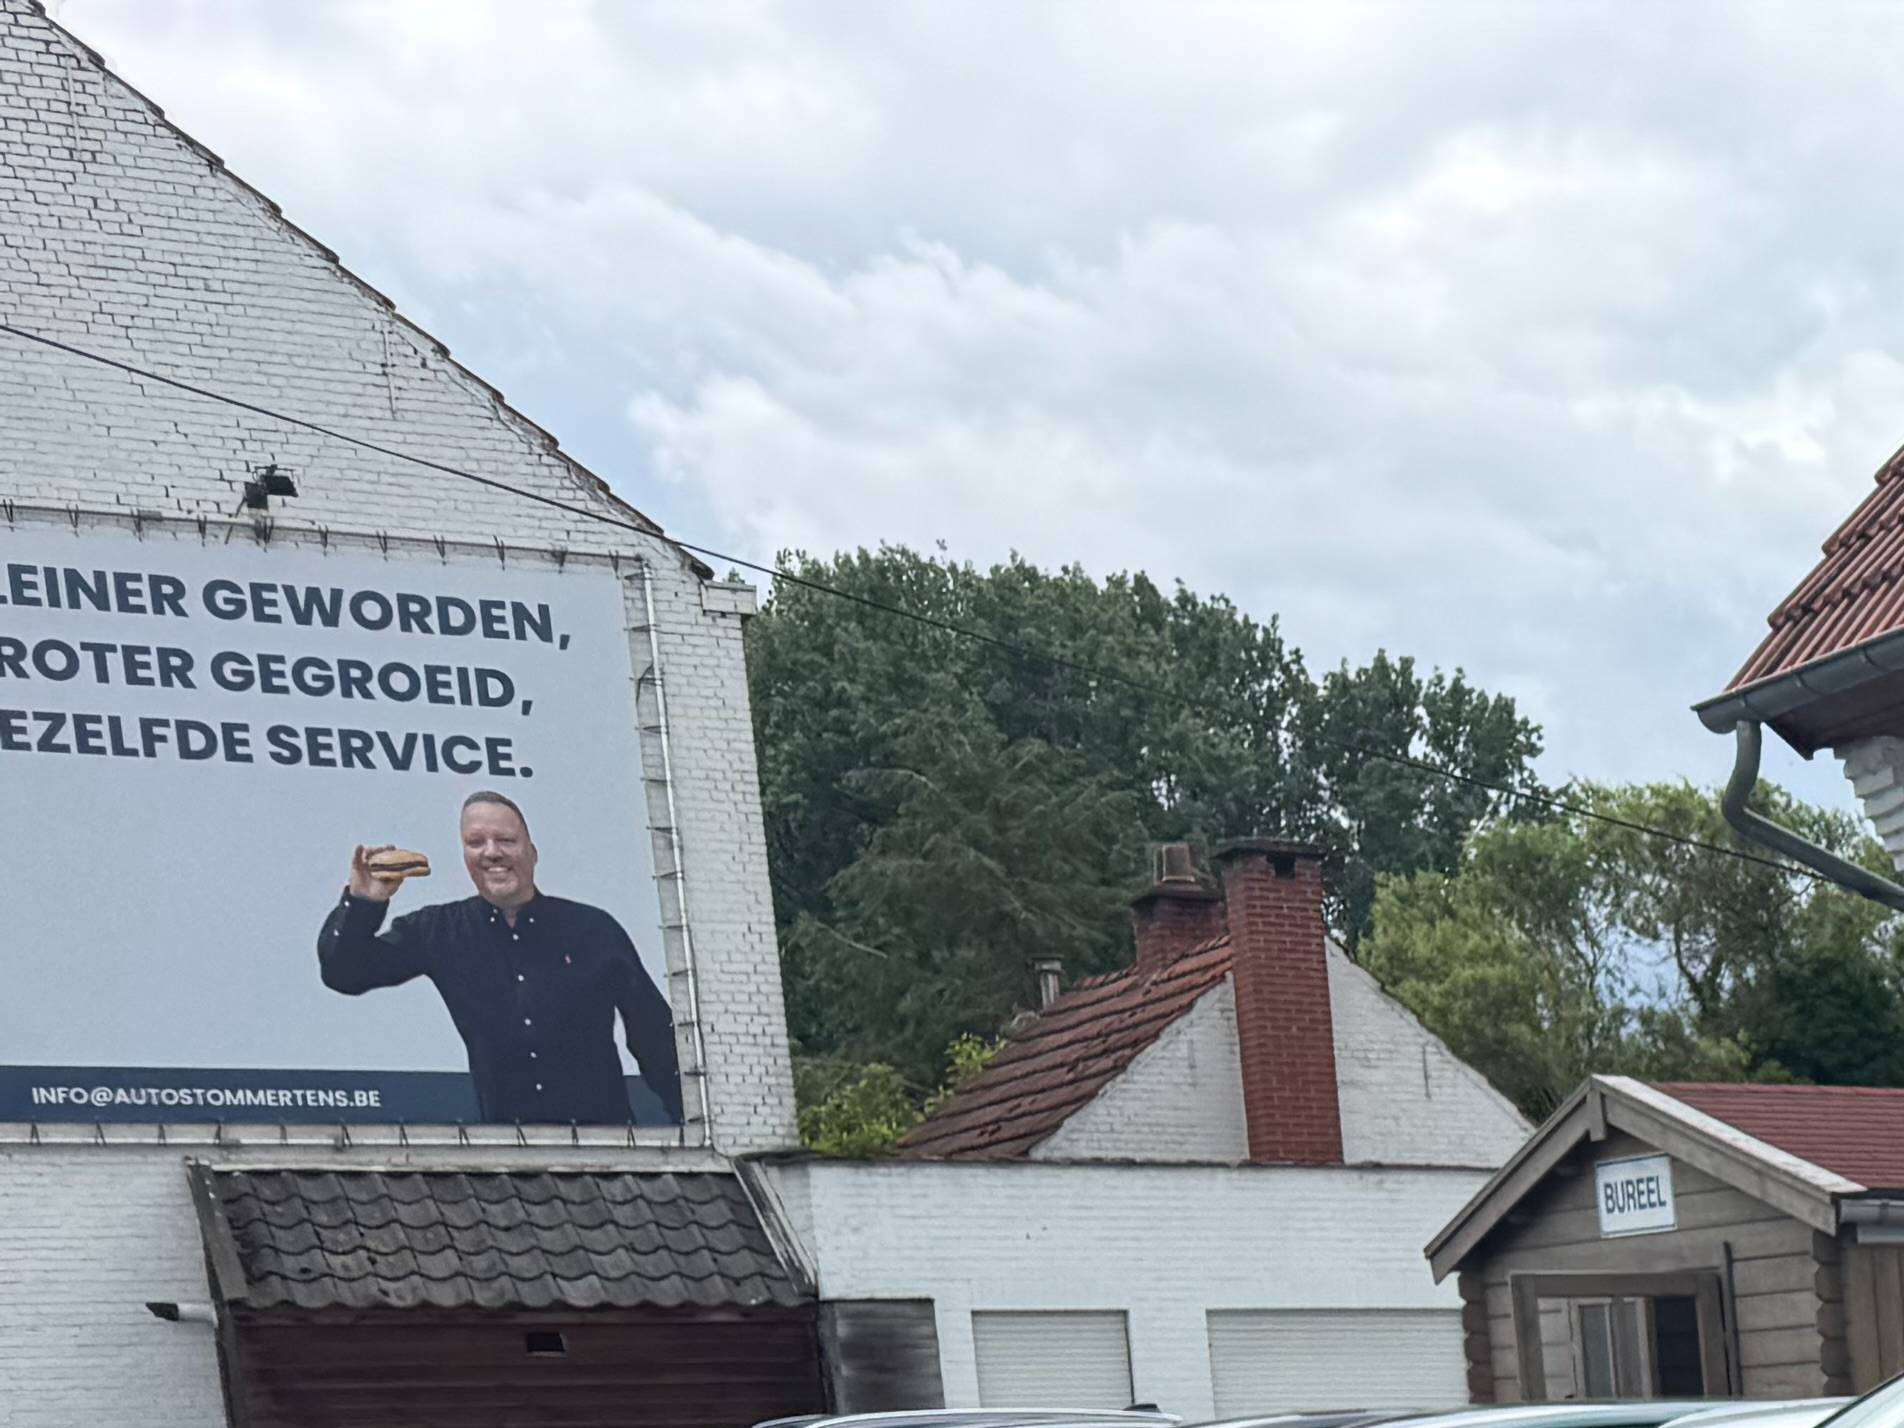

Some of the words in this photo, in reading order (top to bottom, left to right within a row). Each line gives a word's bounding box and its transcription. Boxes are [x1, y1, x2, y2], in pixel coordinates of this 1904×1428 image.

[0, 563, 189, 618] EINER
[202, 578, 571, 651] GEWORDEN,
[210, 651, 534, 716] GEGROEID,
[0, 709, 254, 763] EZELFDE
[266, 724, 534, 779] SERVICE.
[32, 1086, 381, 1108] INFO@AUTOSTOMMERTENS.BE
[1603, 1175, 1668, 1214] BUREEL
